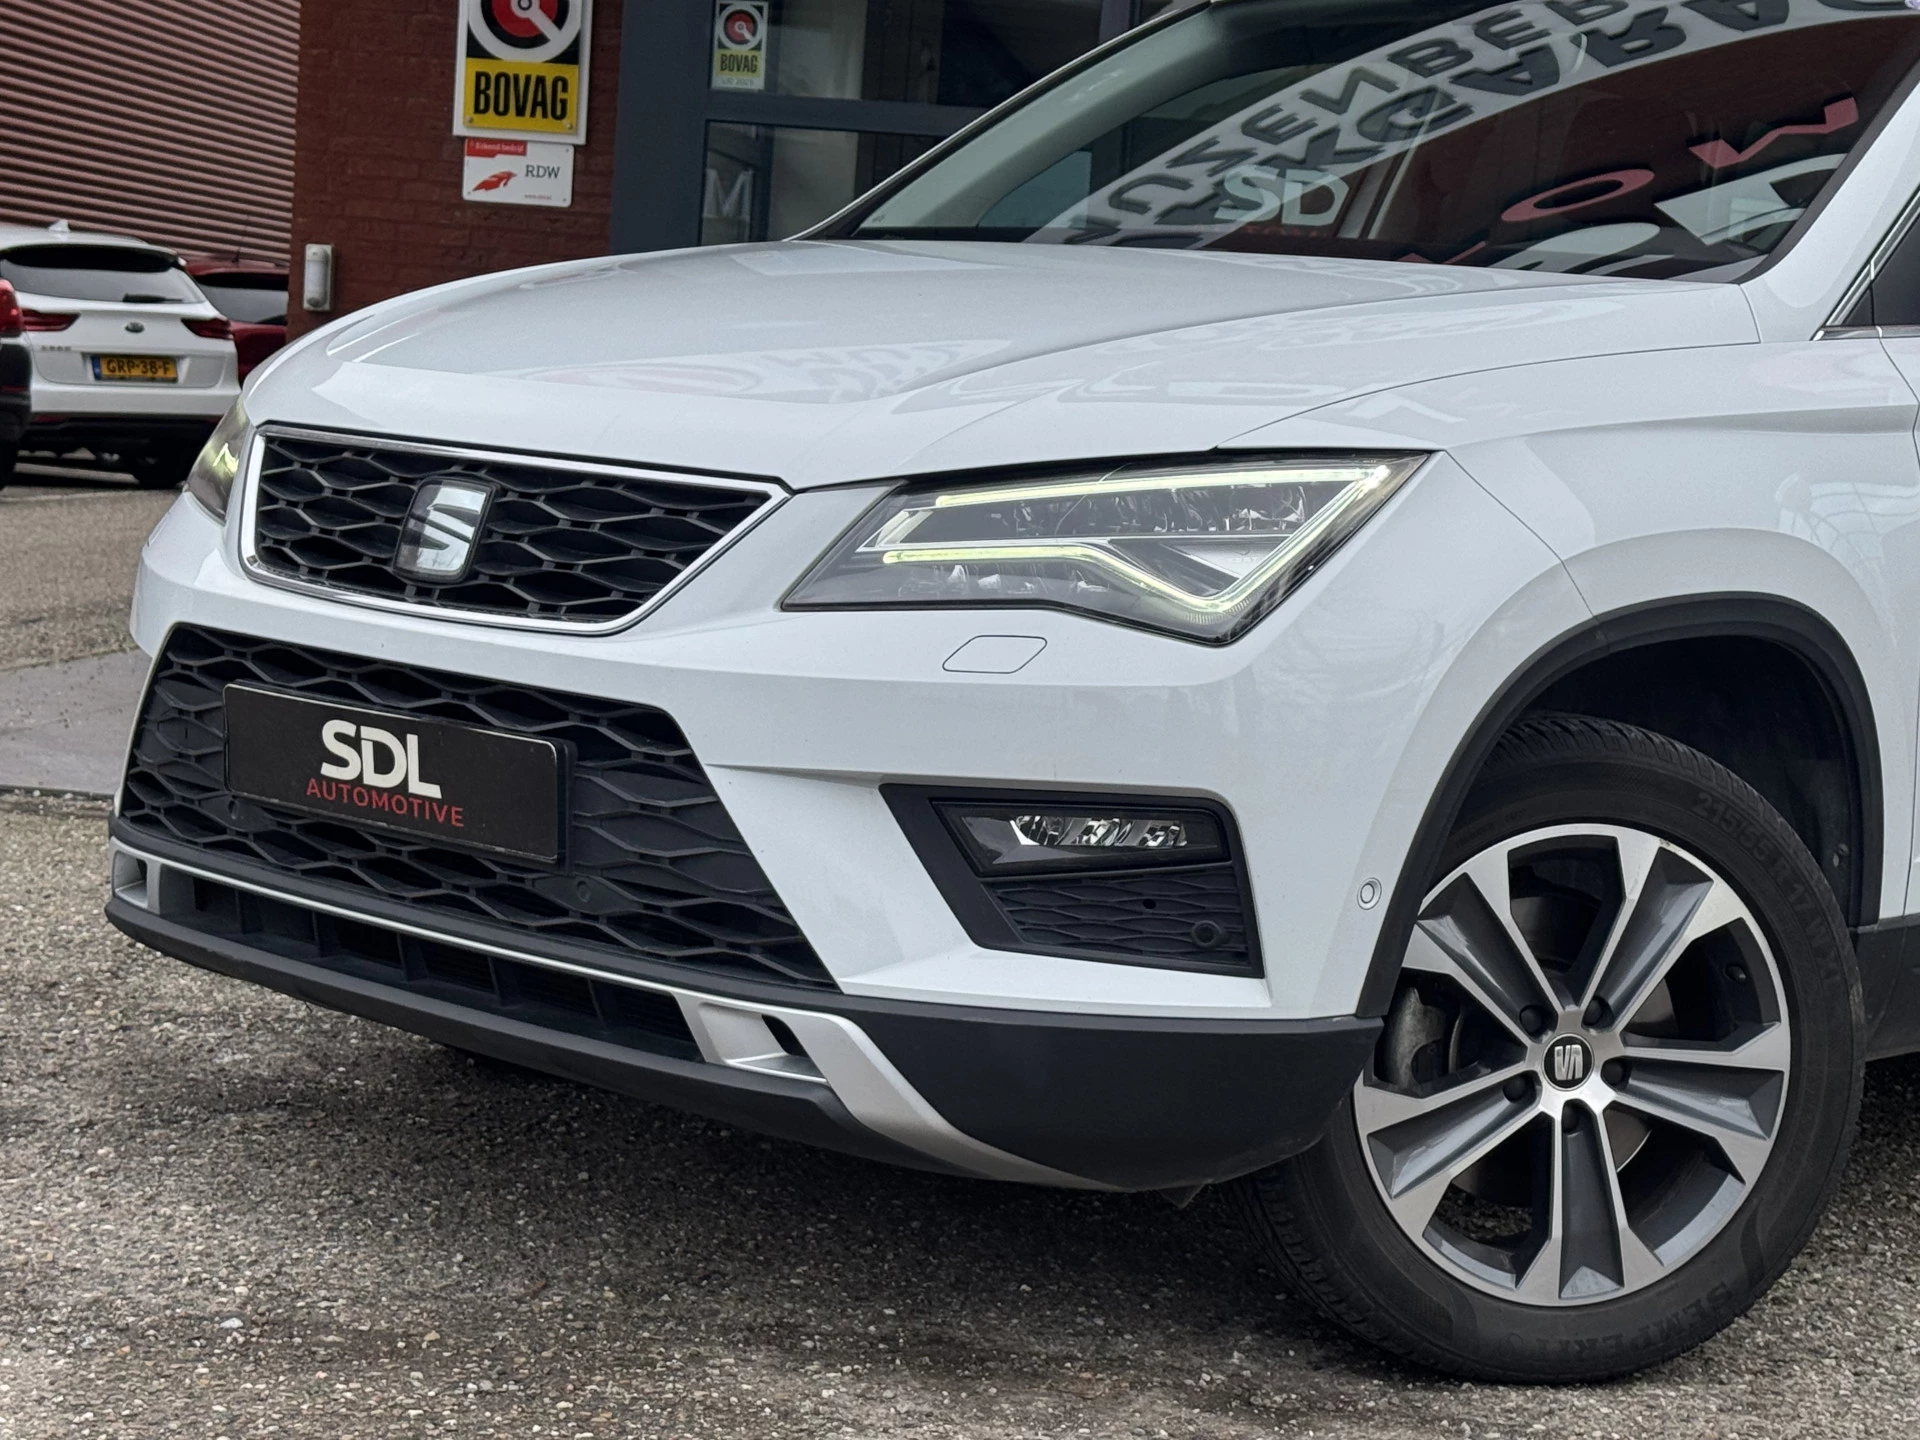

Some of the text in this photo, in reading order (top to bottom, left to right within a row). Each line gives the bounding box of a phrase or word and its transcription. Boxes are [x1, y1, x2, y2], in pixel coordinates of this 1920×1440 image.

[721, 53, 759, 74] BOVAG
[473, 71, 569, 121] BOVAG
[525, 164, 560, 180] RDW
[106, 358, 170, 376] GRP-38-F
[320, 719, 442, 799] SDL
[306, 778, 465, 828] AUTOMOTIVE
